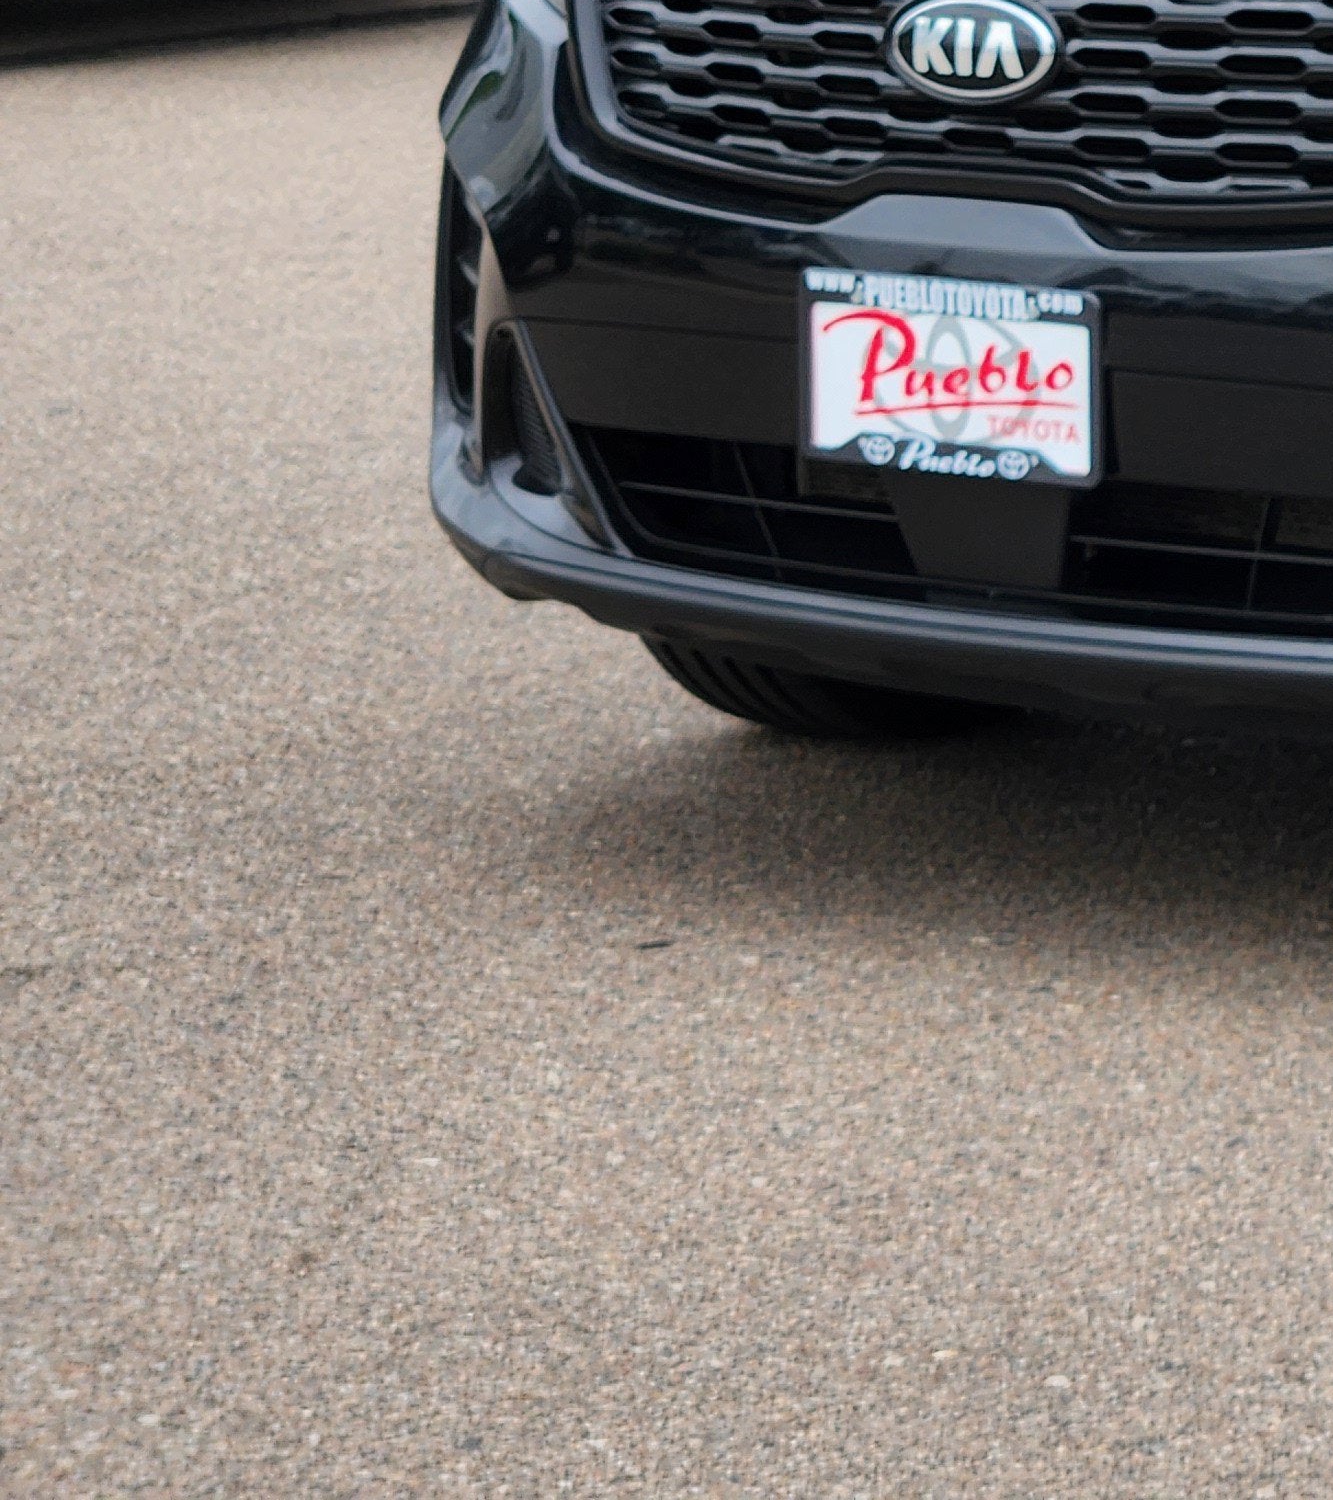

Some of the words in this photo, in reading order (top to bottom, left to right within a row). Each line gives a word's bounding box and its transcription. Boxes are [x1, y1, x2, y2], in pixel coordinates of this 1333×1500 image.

[911, 15, 1025, 80] KIA
[823, 310, 1073, 402] Pueblo
[986, 415, 1080, 443] TOYOTA
